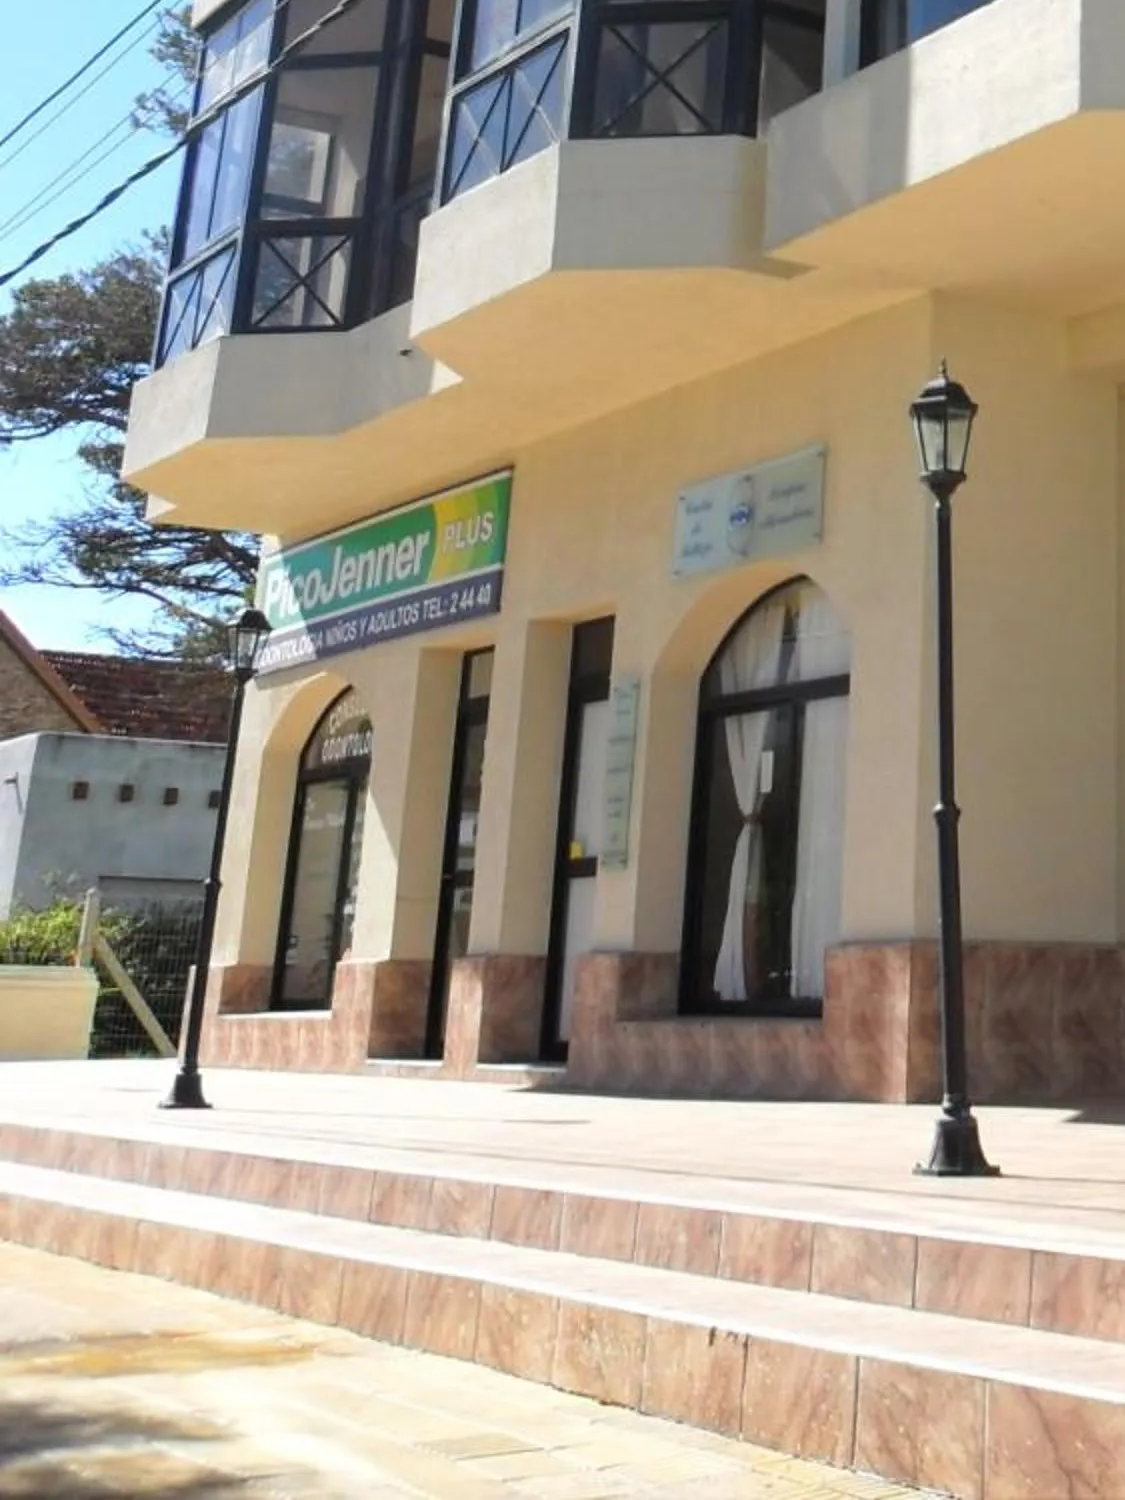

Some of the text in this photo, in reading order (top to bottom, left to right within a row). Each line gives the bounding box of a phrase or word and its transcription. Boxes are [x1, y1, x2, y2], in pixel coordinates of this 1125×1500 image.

[441, 509, 495, 552] PLUS
[325, 619, 358, 648] NIÑOS
[359, 615, 369, 638] Y
[366, 601, 420, 636] ADULTOS
